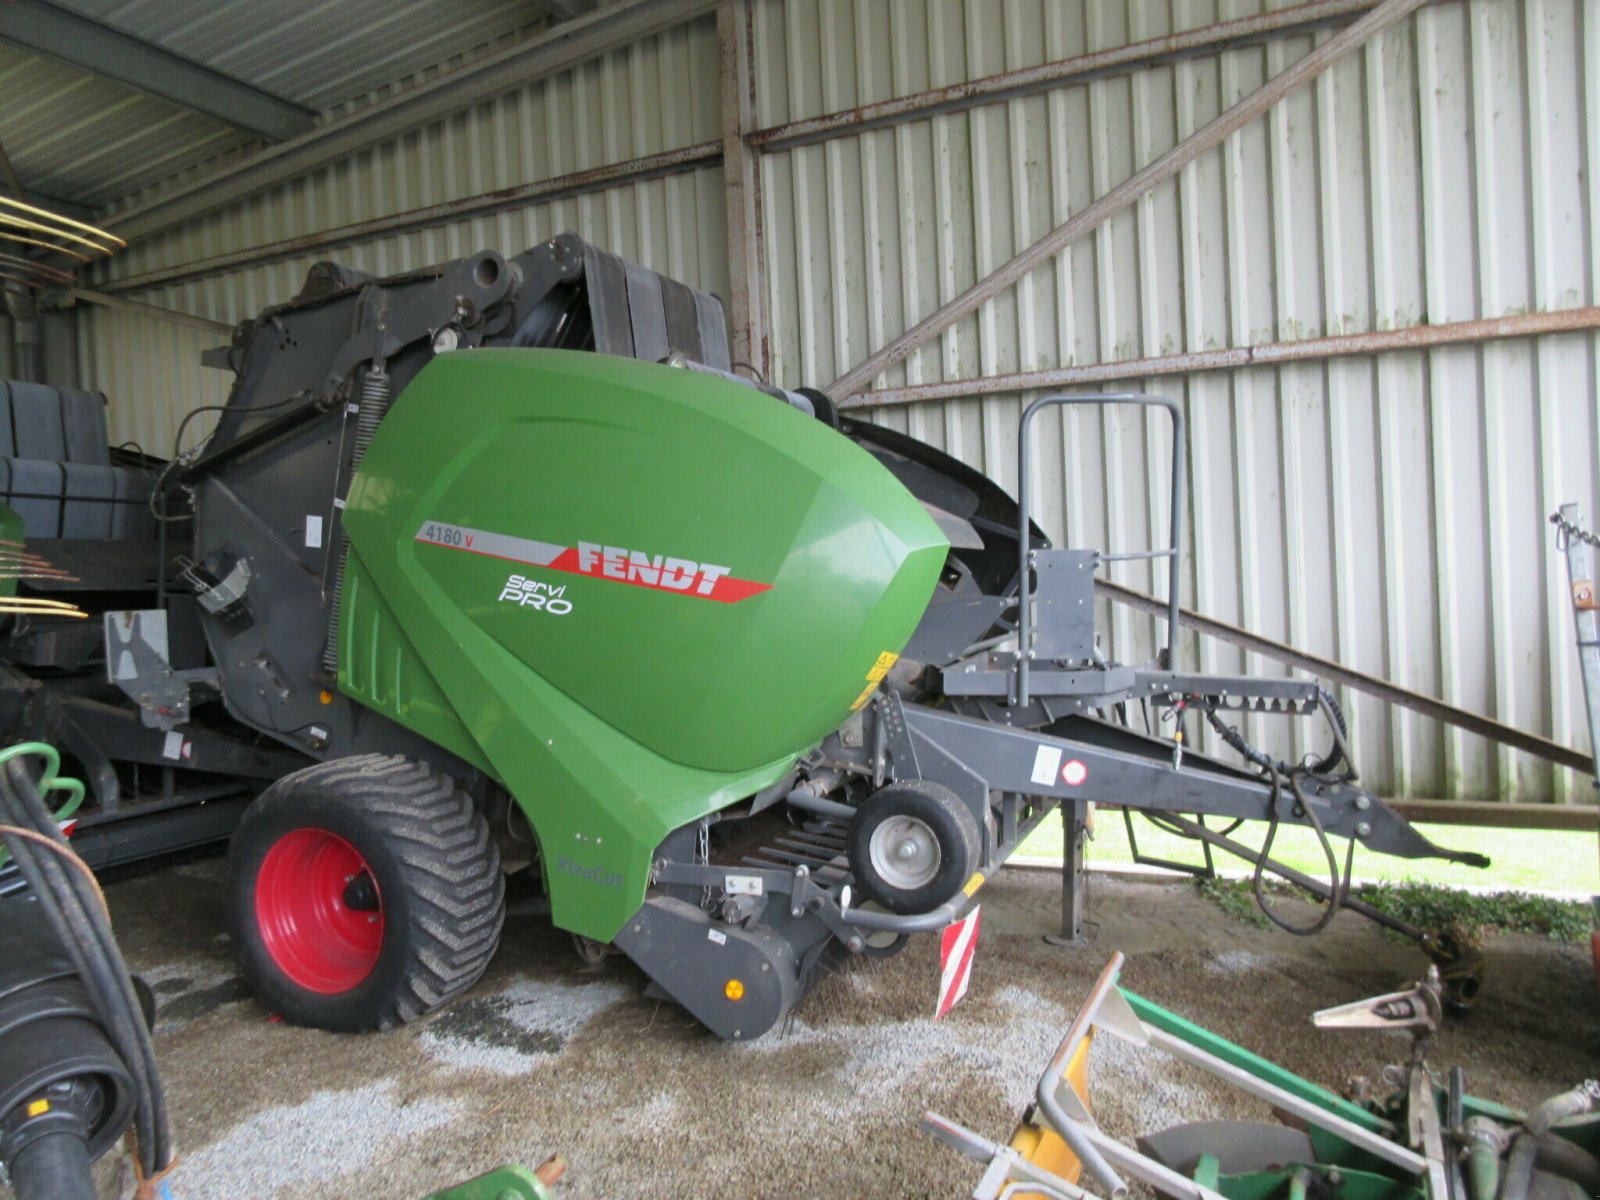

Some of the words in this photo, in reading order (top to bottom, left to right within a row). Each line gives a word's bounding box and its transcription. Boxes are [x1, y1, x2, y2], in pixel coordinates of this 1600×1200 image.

[426, 525, 462, 546] 4180
[578, 540, 731, 595] FENDT
[506, 574, 566, 598] Servi
[498, 587, 573, 615] PRO
[556, 856, 624, 887] XtraCut
